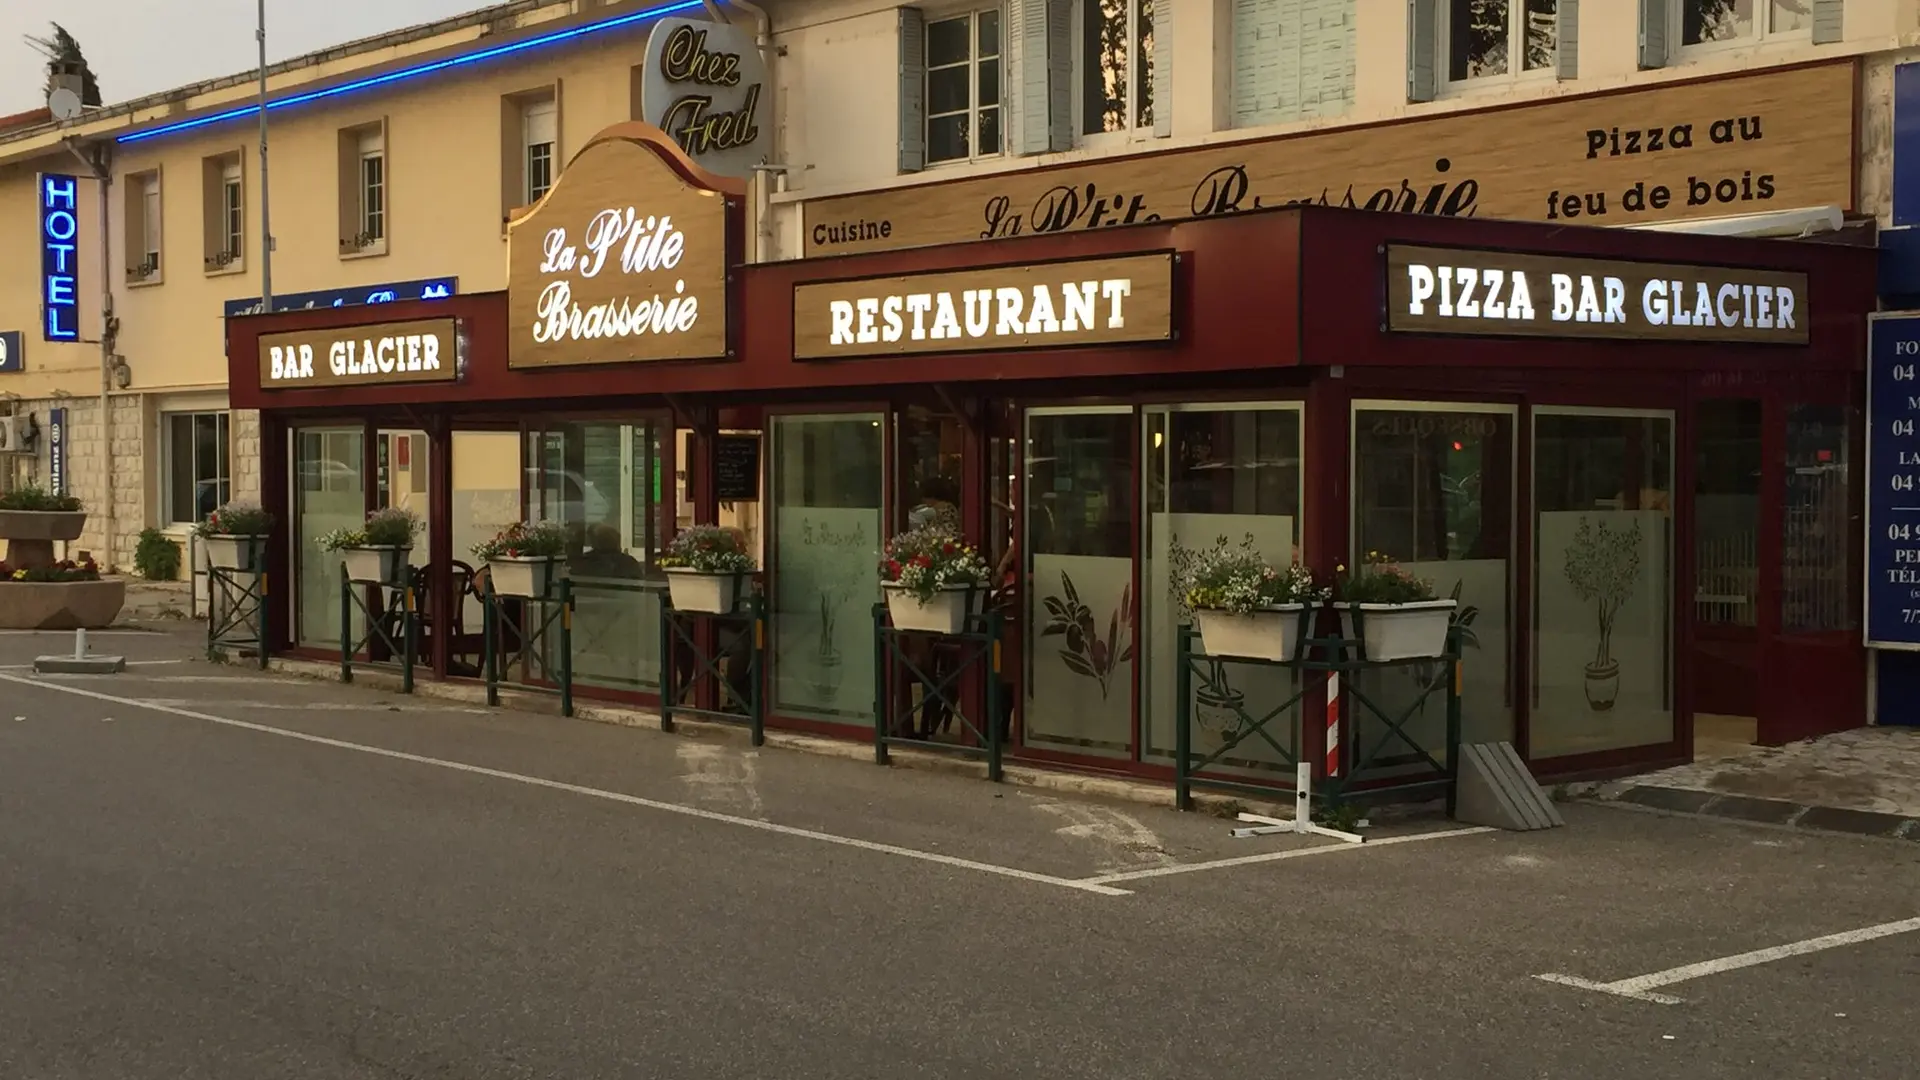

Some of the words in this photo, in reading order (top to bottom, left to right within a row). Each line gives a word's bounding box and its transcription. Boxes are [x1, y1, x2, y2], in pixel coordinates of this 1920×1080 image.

[661, 24, 741, 87] Chez
[660, 84, 761, 157] Fred
[1586, 123, 1692, 159] Pizza
[1710, 116, 1762, 143] au
[1547, 190, 1607, 219] feu
[1622, 182, 1670, 211] de
[1687, 170, 1775, 206] bois
[540, 228, 577, 273] La
[580, 206, 685, 278] P'tite
[813, 217, 892, 245] Cuisine
[46, 179, 76, 338] HOTEL
[533, 279, 698, 343] Brasserie
[830, 279, 1131, 345] RESTAURANT
[1408, 264, 1535, 319] PIZZA
[1552, 273, 1627, 323] BAR
[1642, 278, 1796, 329] GLACIER
[270, 342, 314, 379] BAR
[329, 333, 441, 376] GLACIER
[1896, 341, 1920, 354] FO
[1893, 364, 1915, 380] 04
[1892, 419, 1914, 436] 04
[1892, 474, 1913, 491] 04
[1888, 523, 1910, 540] 04
